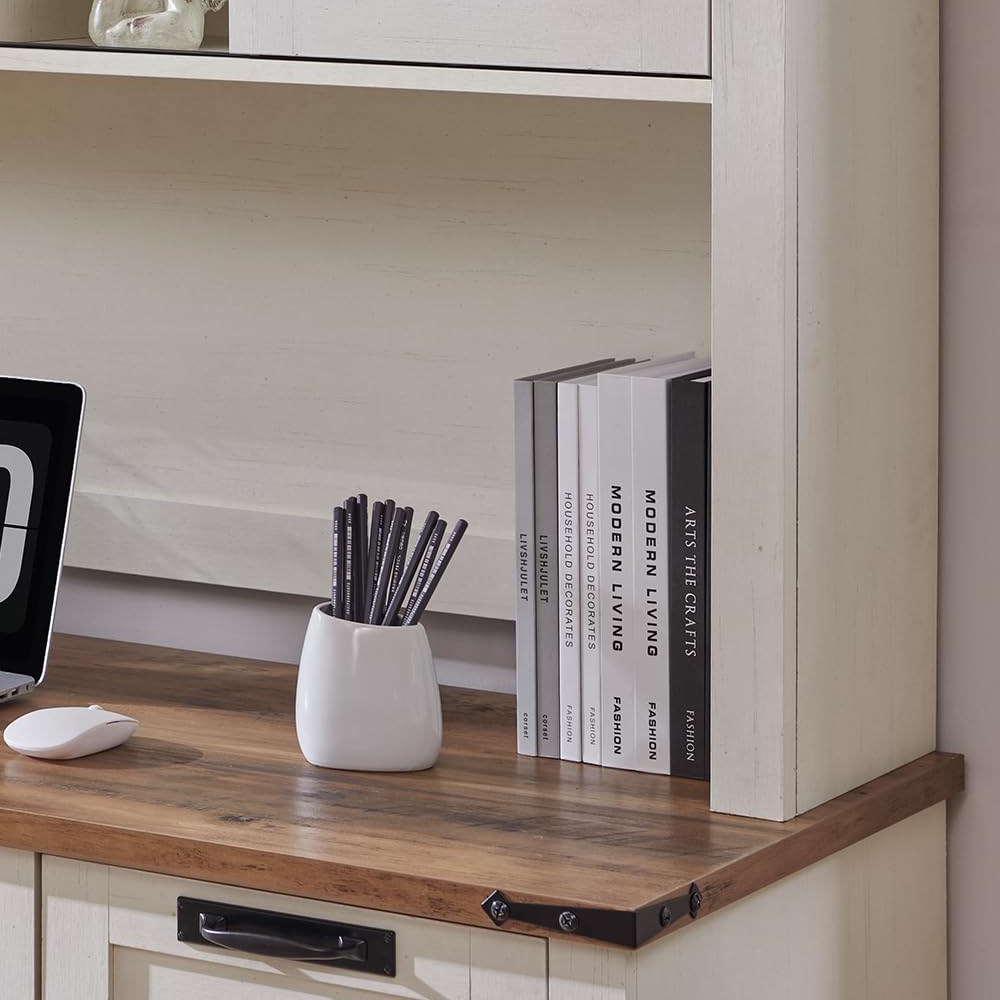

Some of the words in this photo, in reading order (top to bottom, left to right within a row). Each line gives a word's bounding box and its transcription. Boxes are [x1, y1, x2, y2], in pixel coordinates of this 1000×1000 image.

[564, 492, 573, 568] HOUSEHOLD
[586, 493, 595, 570] HOUSEHOLD
[611, 486, 622, 572] MODERN
[645, 490, 656, 576] MODERN
[685, 506, 696, 548] ARTS
[519, 533, 529, 601] LIVSHJULET
[539, 535, 549, 603] LIVSHJULET
[685, 555, 696, 586] THE
[565, 574, 573, 648] DECORATES
[587, 575, 596, 650] DECORATES
[612, 583, 623, 651] LIVING
[647, 588, 658, 656] LIVING
[685, 593, 697, 657] CRAFTS
[613, 697, 621, 755] FASHION
[648, 702, 657, 760] FASHION
[686, 710, 695, 761] FASHION
